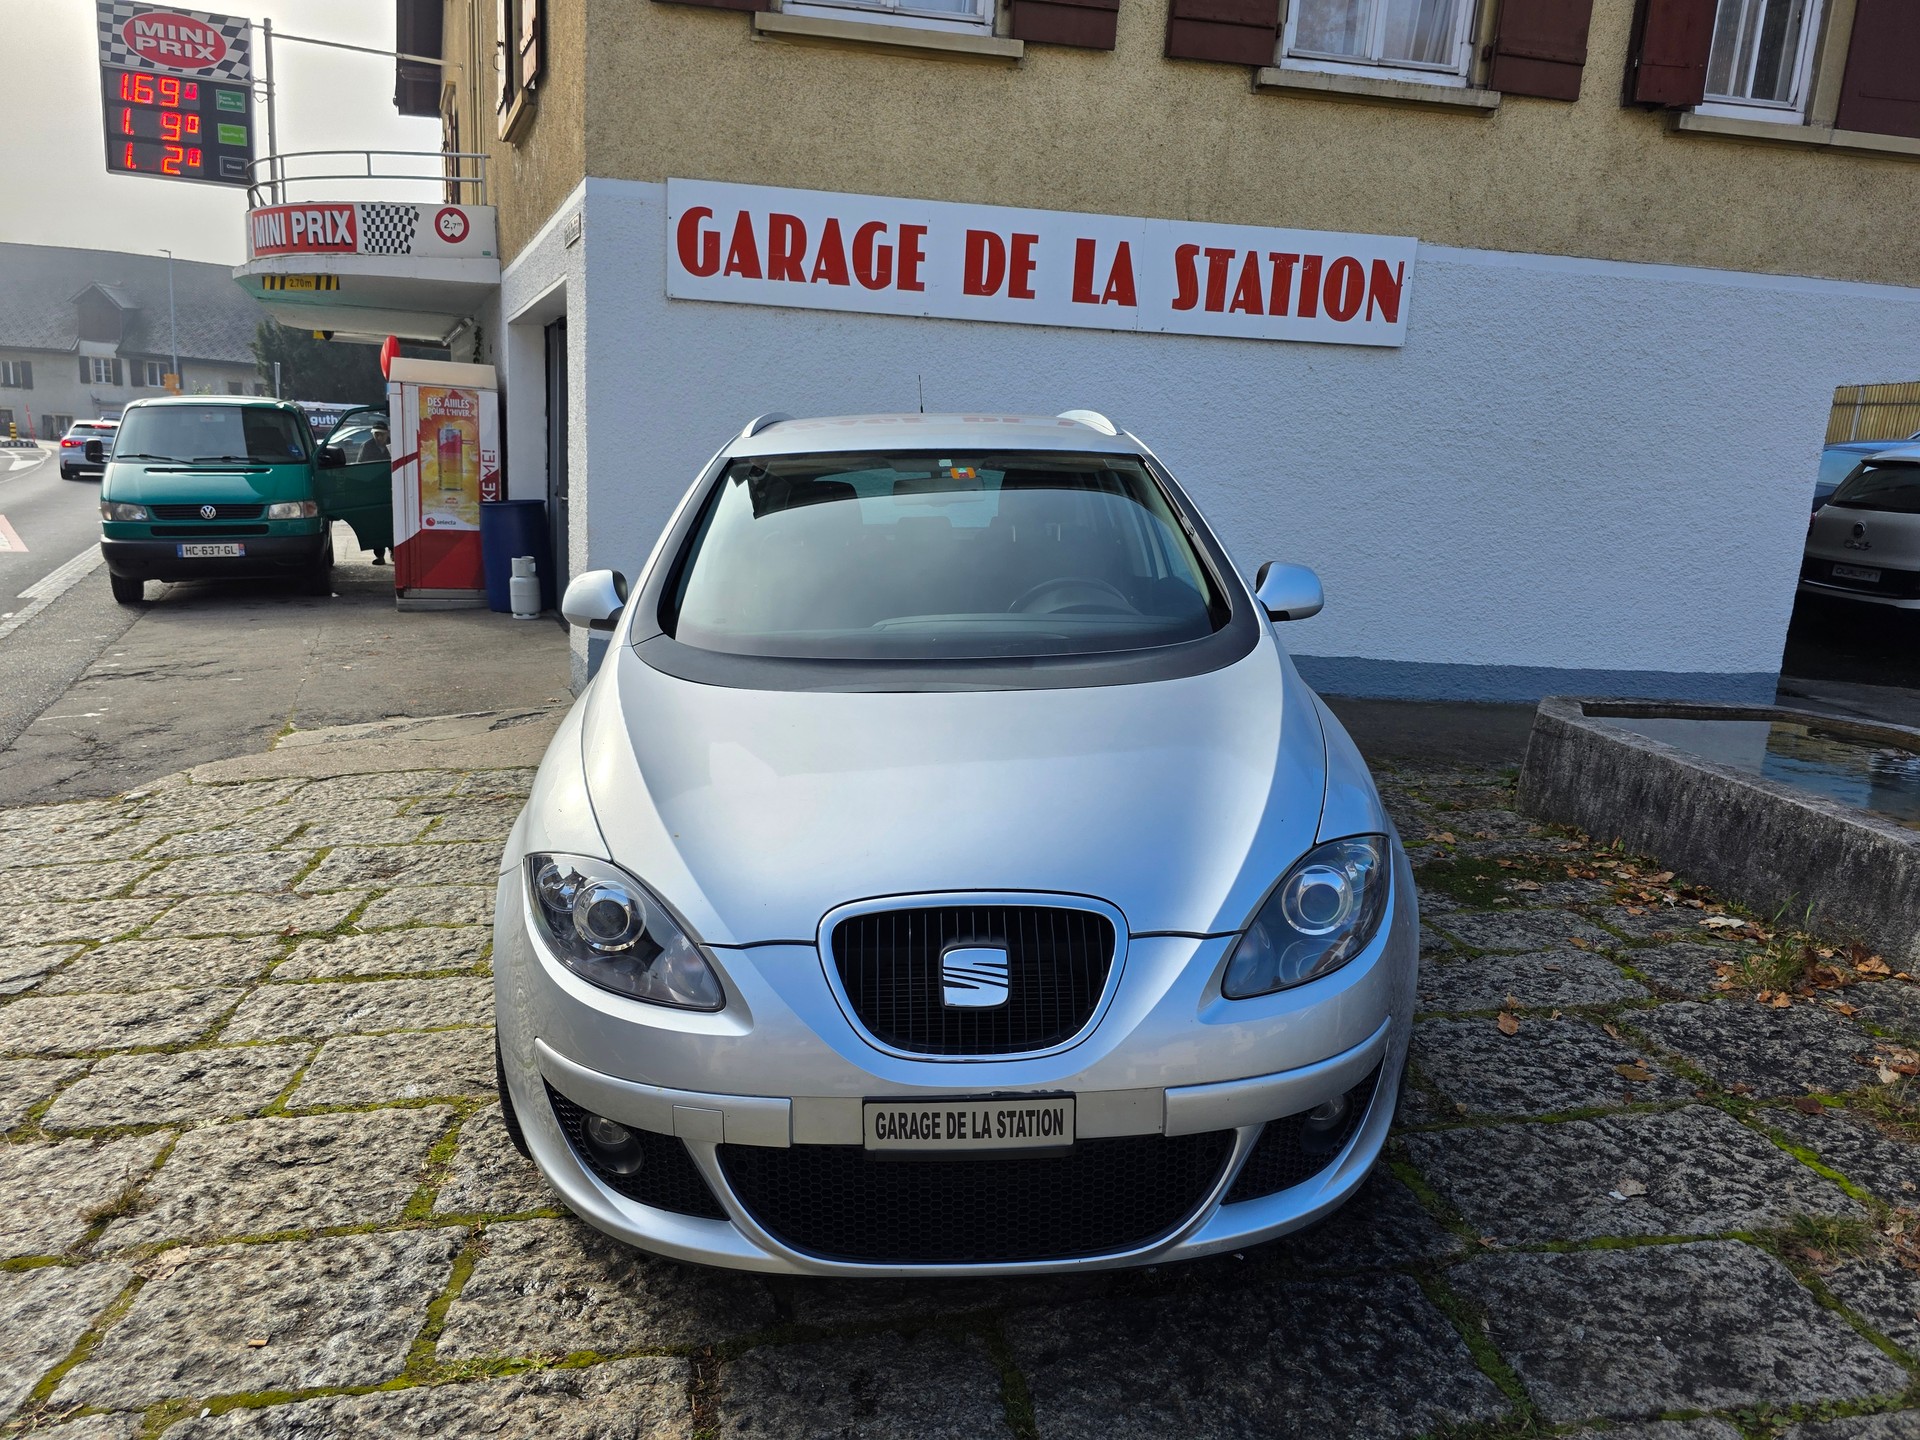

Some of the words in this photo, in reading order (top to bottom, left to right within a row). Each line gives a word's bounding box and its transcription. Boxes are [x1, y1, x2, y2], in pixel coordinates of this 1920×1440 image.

[134, 20, 215, 46] MINI
[135, 37, 217, 61] PRIX
[254, 211, 287, 249] MINI
[290, 209, 354, 247] PRIX
[675, 205, 929, 293] GARAGE
[962, 229, 1040, 300] DE
[1070, 238, 1139, 308] LA
[1171, 242, 1406, 325] STATION
[427, 397, 442, 407] DES
[428, 407, 446, 416] POUR
[309, 414, 339, 426] guth
[482, 449, 496, 478] ME!
[482, 482, 496, 502] KE
[875, 1111, 942, 1140] GARAGE
[946, 1111, 967, 1140] DE
[972, 1110, 993, 1139] LA
[996, 1108, 1064, 1139] STATION
